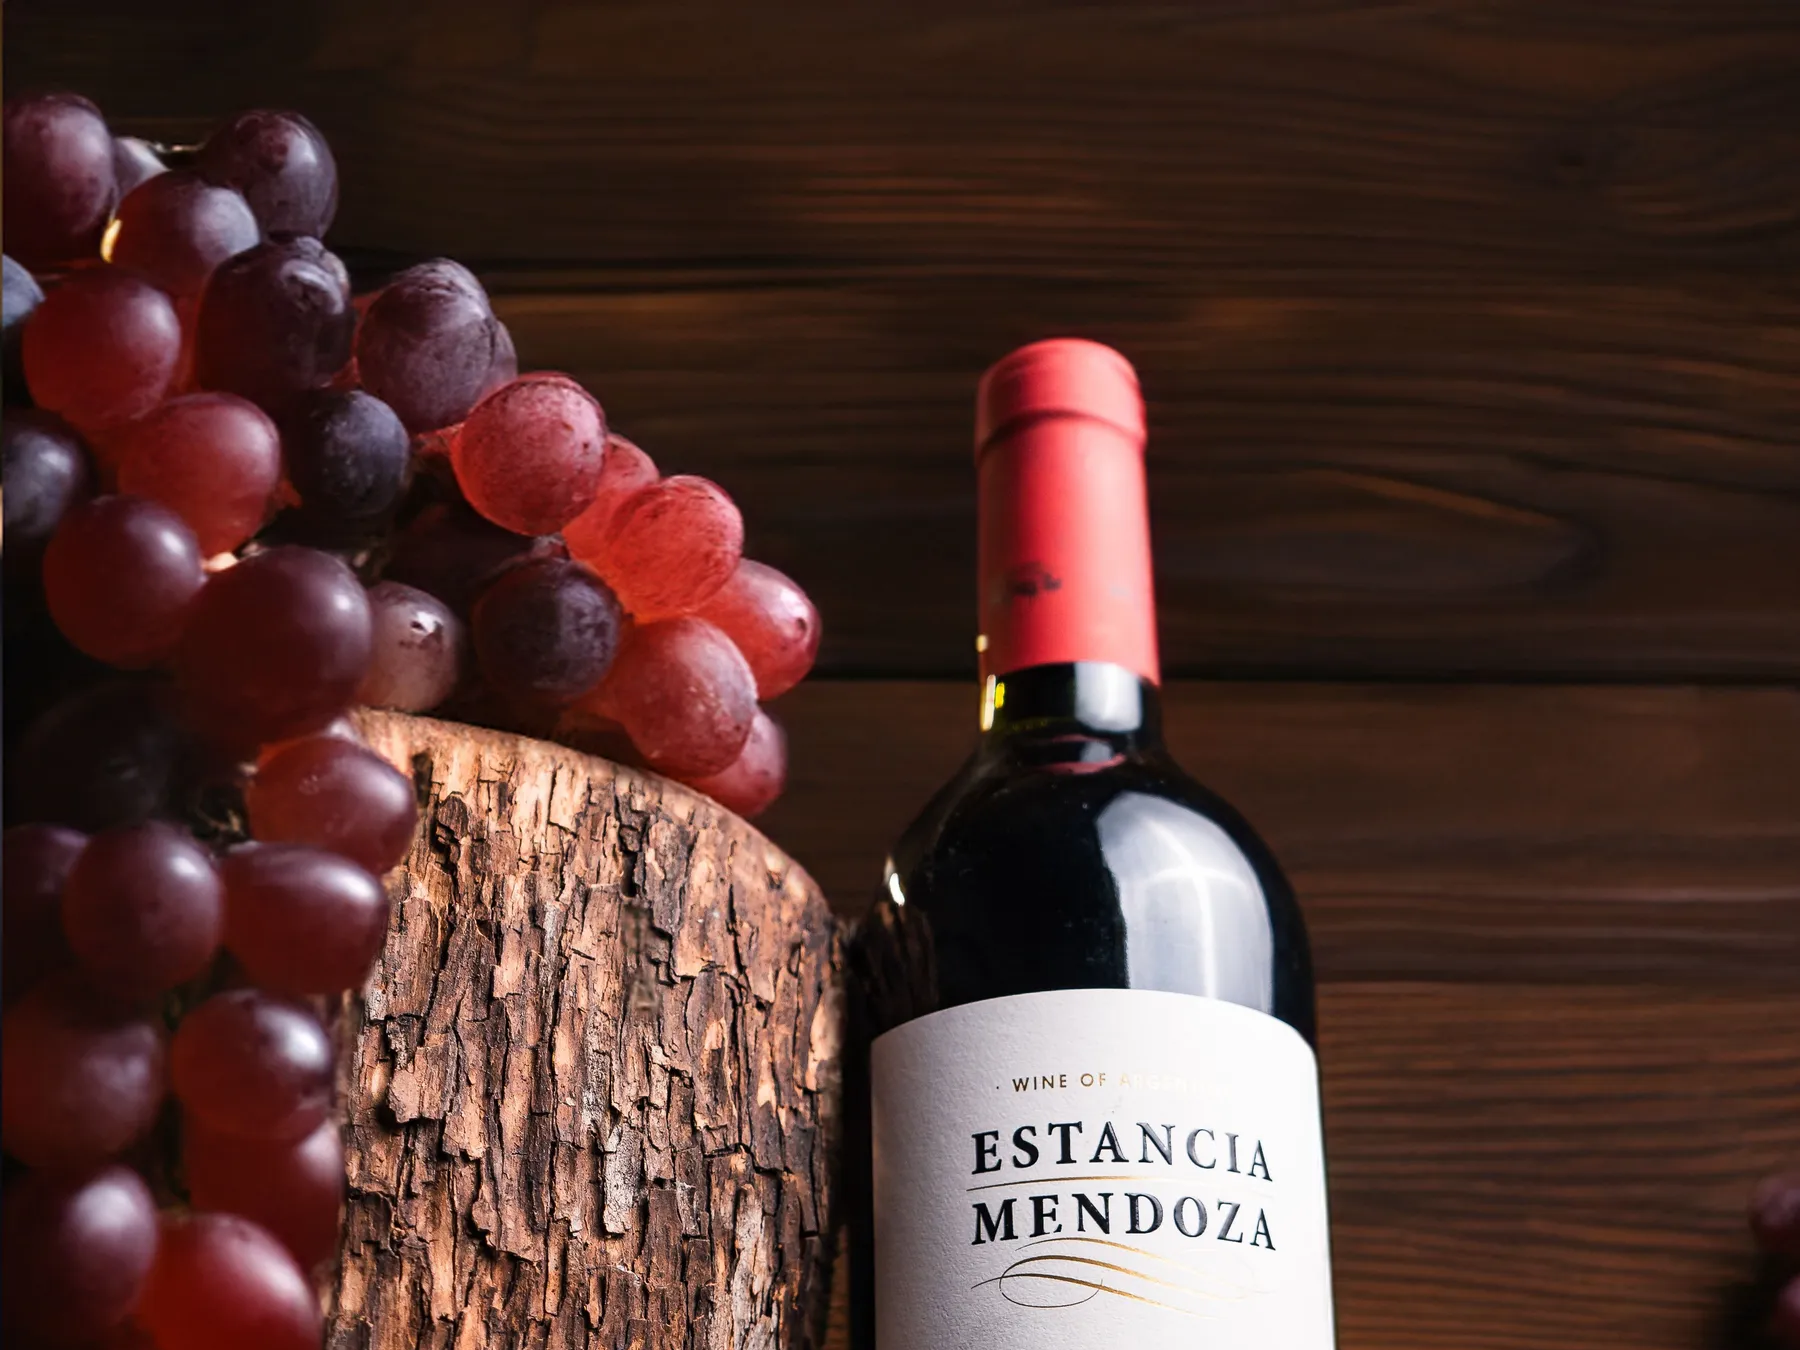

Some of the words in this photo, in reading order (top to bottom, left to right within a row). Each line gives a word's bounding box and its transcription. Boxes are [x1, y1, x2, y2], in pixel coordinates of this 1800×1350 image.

[1012, 1074, 1067, 1092] WINE
[1080, 1073, 1106, 1088] OF
[971, 1120, 1273, 1182] ESTANCIA
[971, 1192, 1276, 1251] MENDOZA
